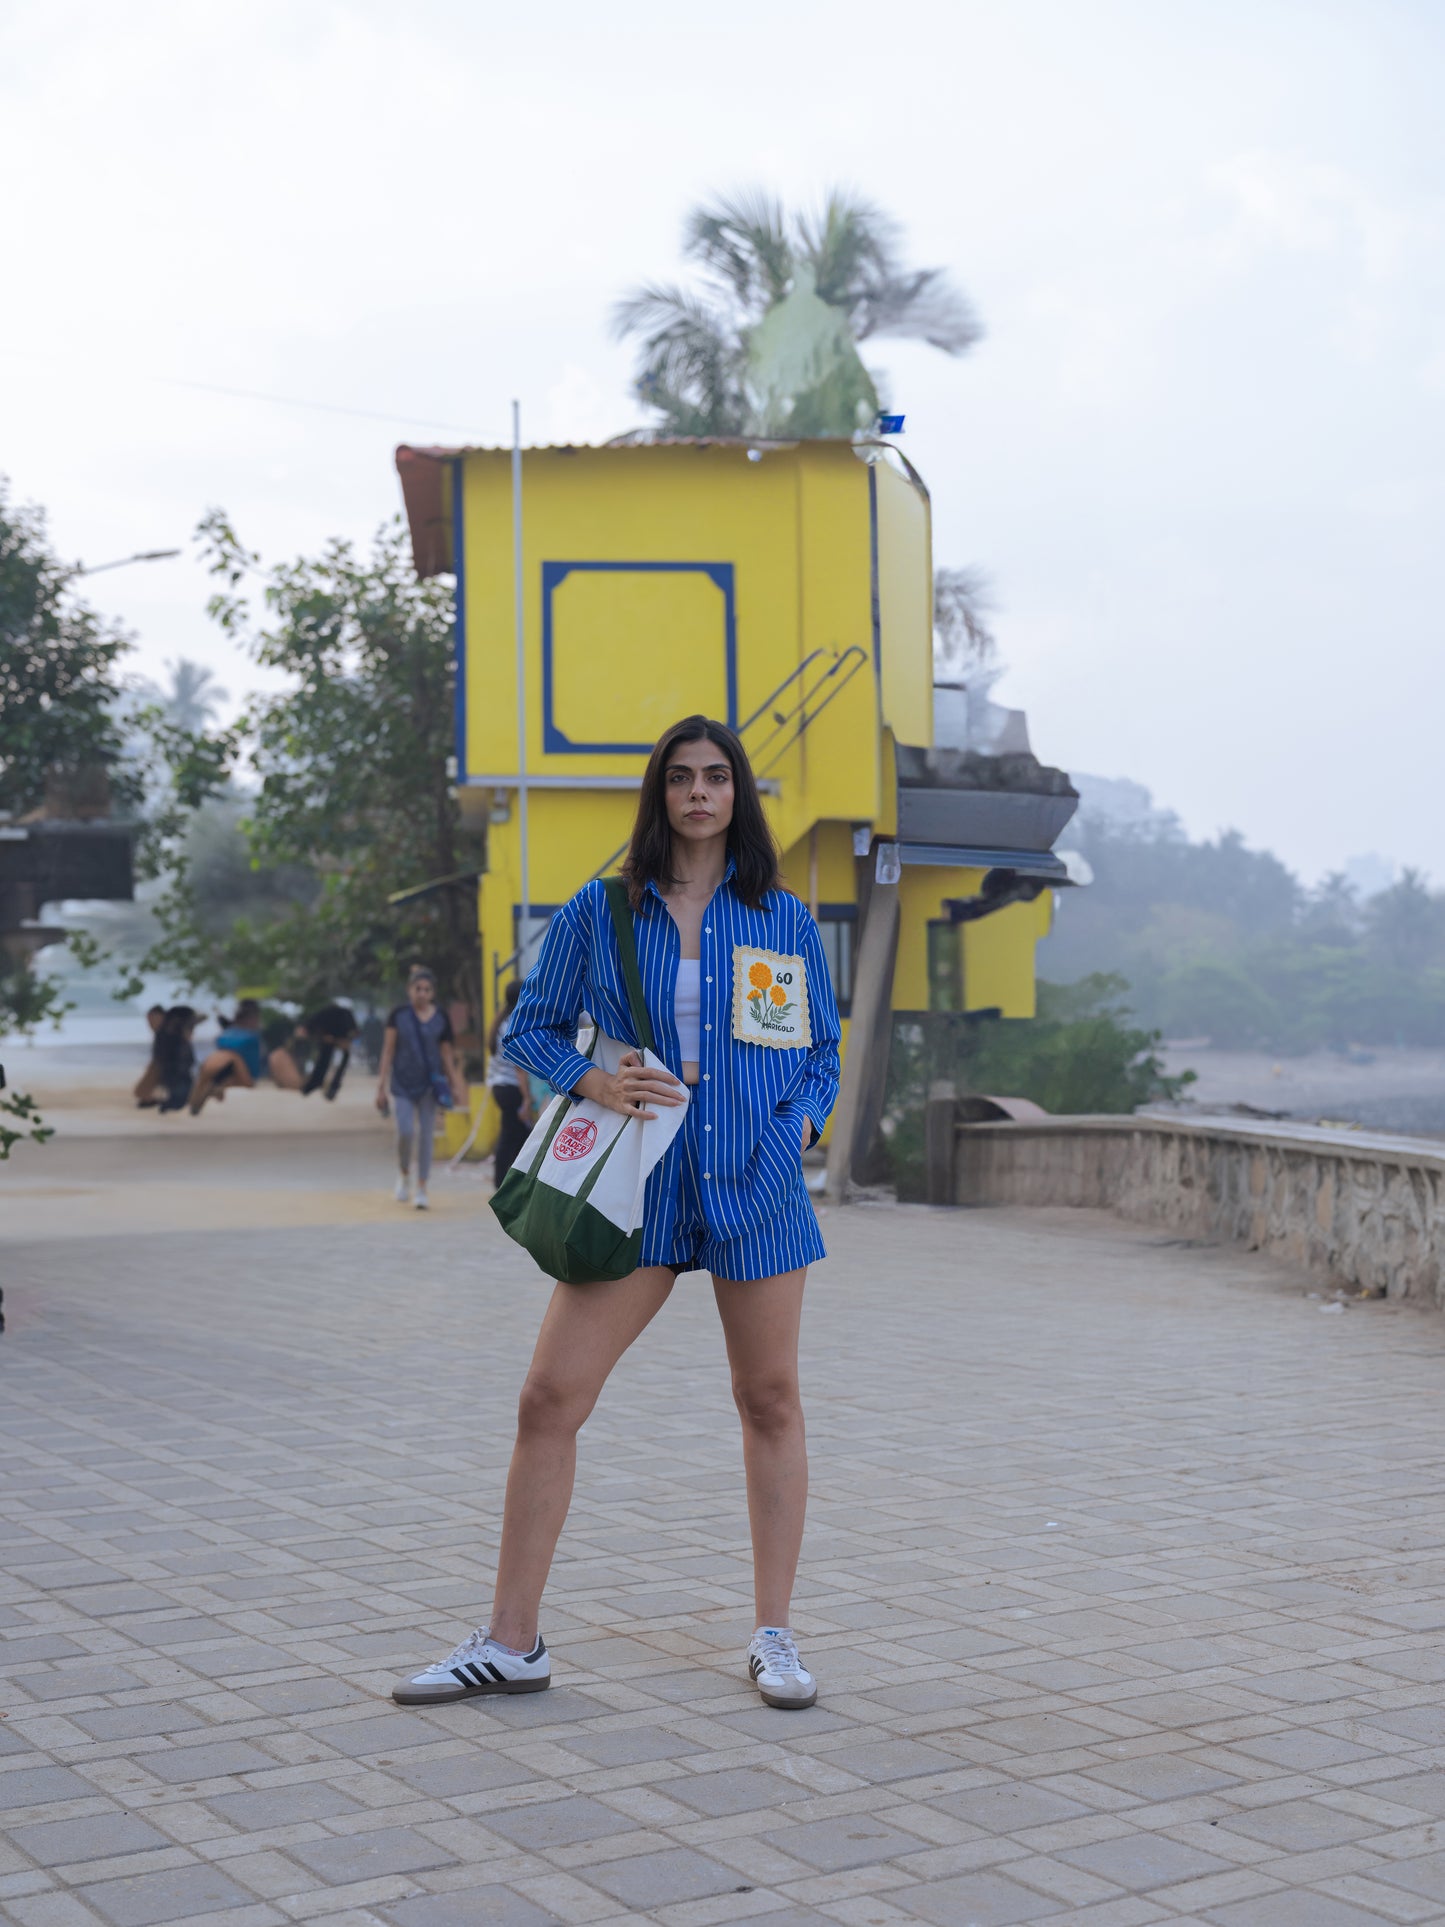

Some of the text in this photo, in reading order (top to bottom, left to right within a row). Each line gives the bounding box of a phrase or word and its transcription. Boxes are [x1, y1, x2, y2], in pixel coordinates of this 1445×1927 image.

[776, 972, 793, 985] 60
[761, 1022, 795, 1033] MARIGOLD
[558, 1133, 587, 1153] TRADER
[556, 1144, 577, 1157] JOE'S
